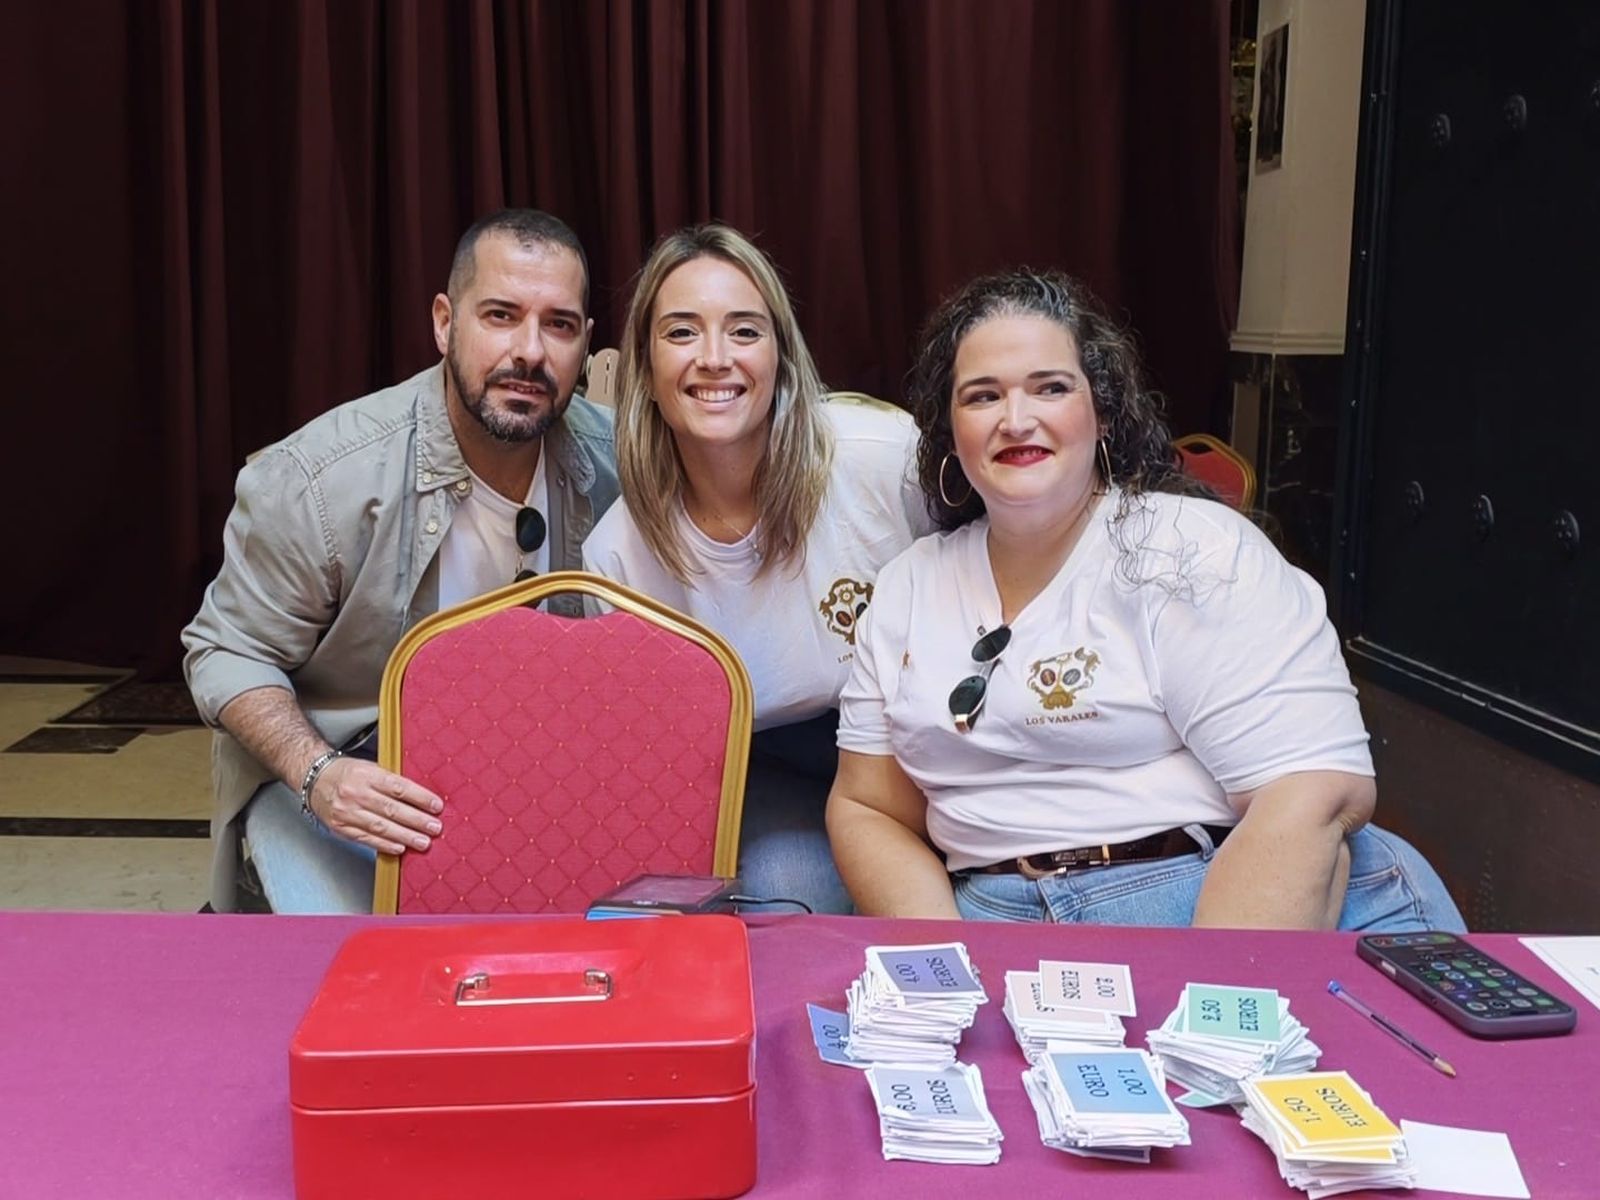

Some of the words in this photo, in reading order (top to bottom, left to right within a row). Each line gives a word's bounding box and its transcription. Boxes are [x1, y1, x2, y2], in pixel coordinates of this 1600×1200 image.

[1025, 716, 1046, 726] LOS
[925, 956, 960, 988] EUROS
[1061, 970, 1082, 1001] EUROS
[1201, 999, 1222, 1022] 2,50
[1237, 997, 1259, 1032] EUROS
[1077, 1064, 1110, 1098] EURO
[1117, 1068, 1147, 1096] 1,00
[1283, 1096, 1322, 1123] 1,50
[1315, 1087, 1368, 1128] EUROS
